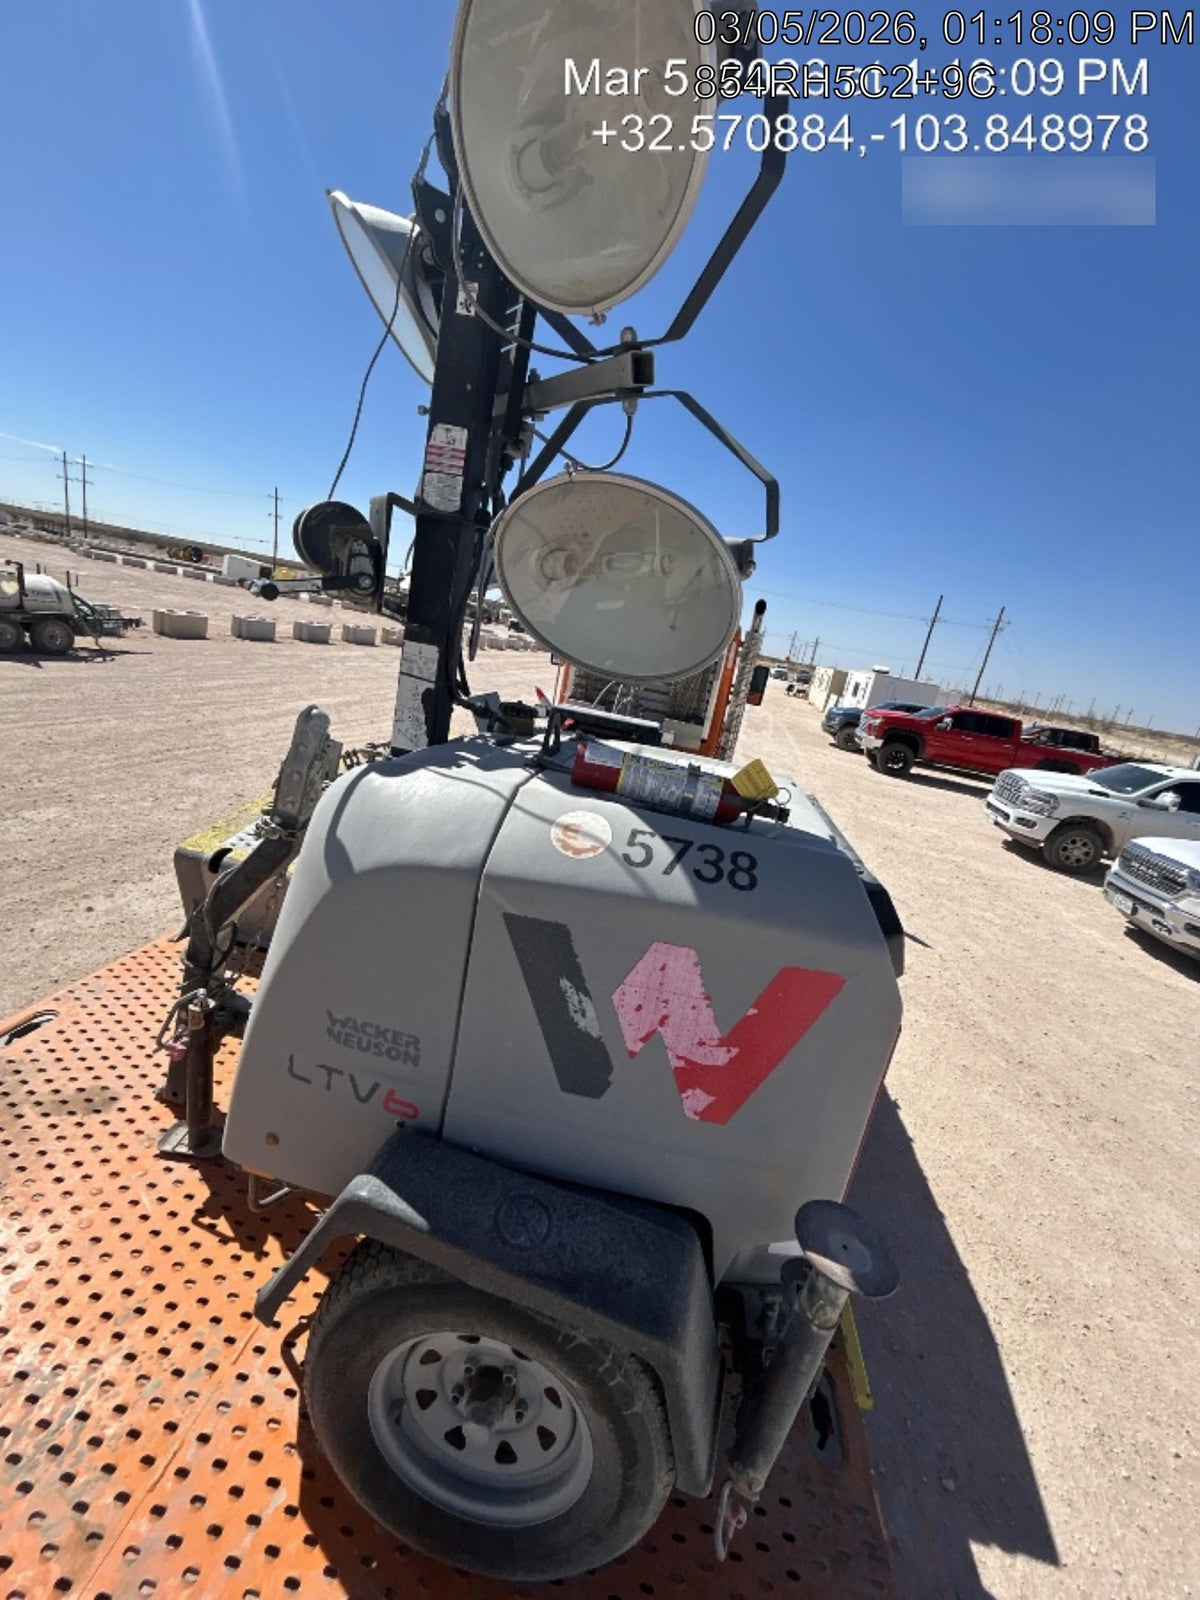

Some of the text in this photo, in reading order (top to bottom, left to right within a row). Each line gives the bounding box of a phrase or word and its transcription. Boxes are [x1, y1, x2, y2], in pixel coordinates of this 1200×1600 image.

[621, 827, 759, 892] 5738
[326, 1009, 421, 1051] WACKER
[326, 1027, 421, 1068] NEUSON
[287, 1053, 421, 1120] LTV6
